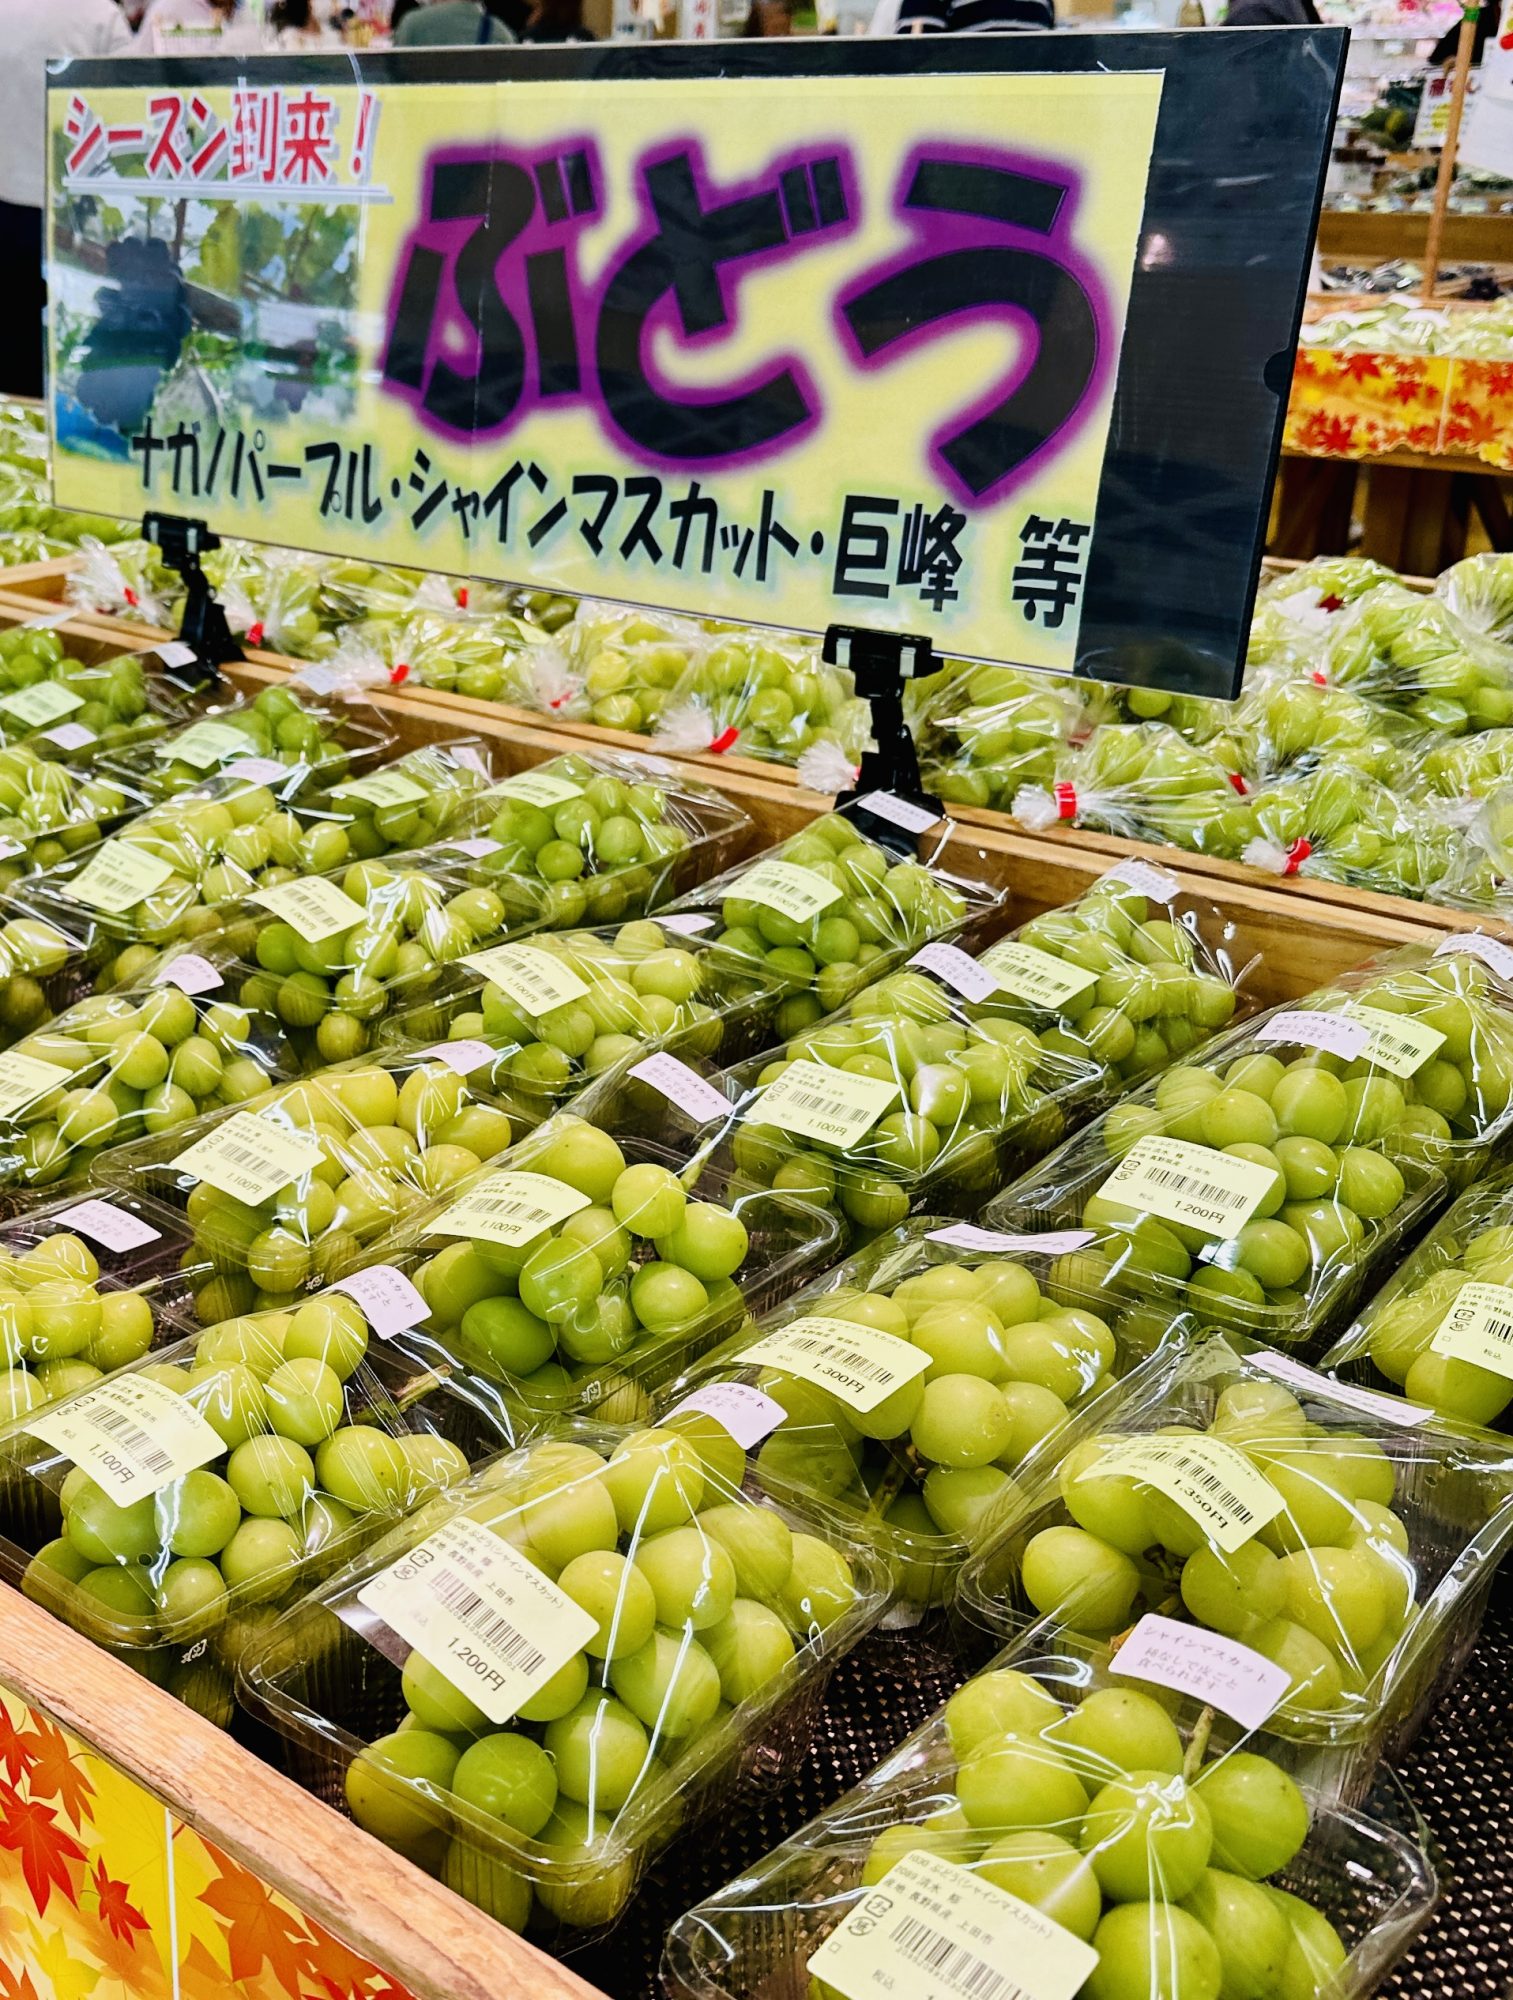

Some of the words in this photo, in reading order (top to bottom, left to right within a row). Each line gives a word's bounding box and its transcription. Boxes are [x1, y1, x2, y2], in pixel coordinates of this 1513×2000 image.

[382, 150, 1100, 498] ぶどう
[132, 417, 968, 613] ナガノパープル・シャインマスカット・巨峰
[1011, 513, 1091, 628] 等
[89, 1442, 136, 1485] 1,100円
[485, 1581, 516, 1606] 上田市
[447, 1636, 507, 1692] 1,200円
[1143, 1625, 1269, 1685] シャインマスカット
[956, 1919, 996, 1946] 上田市
